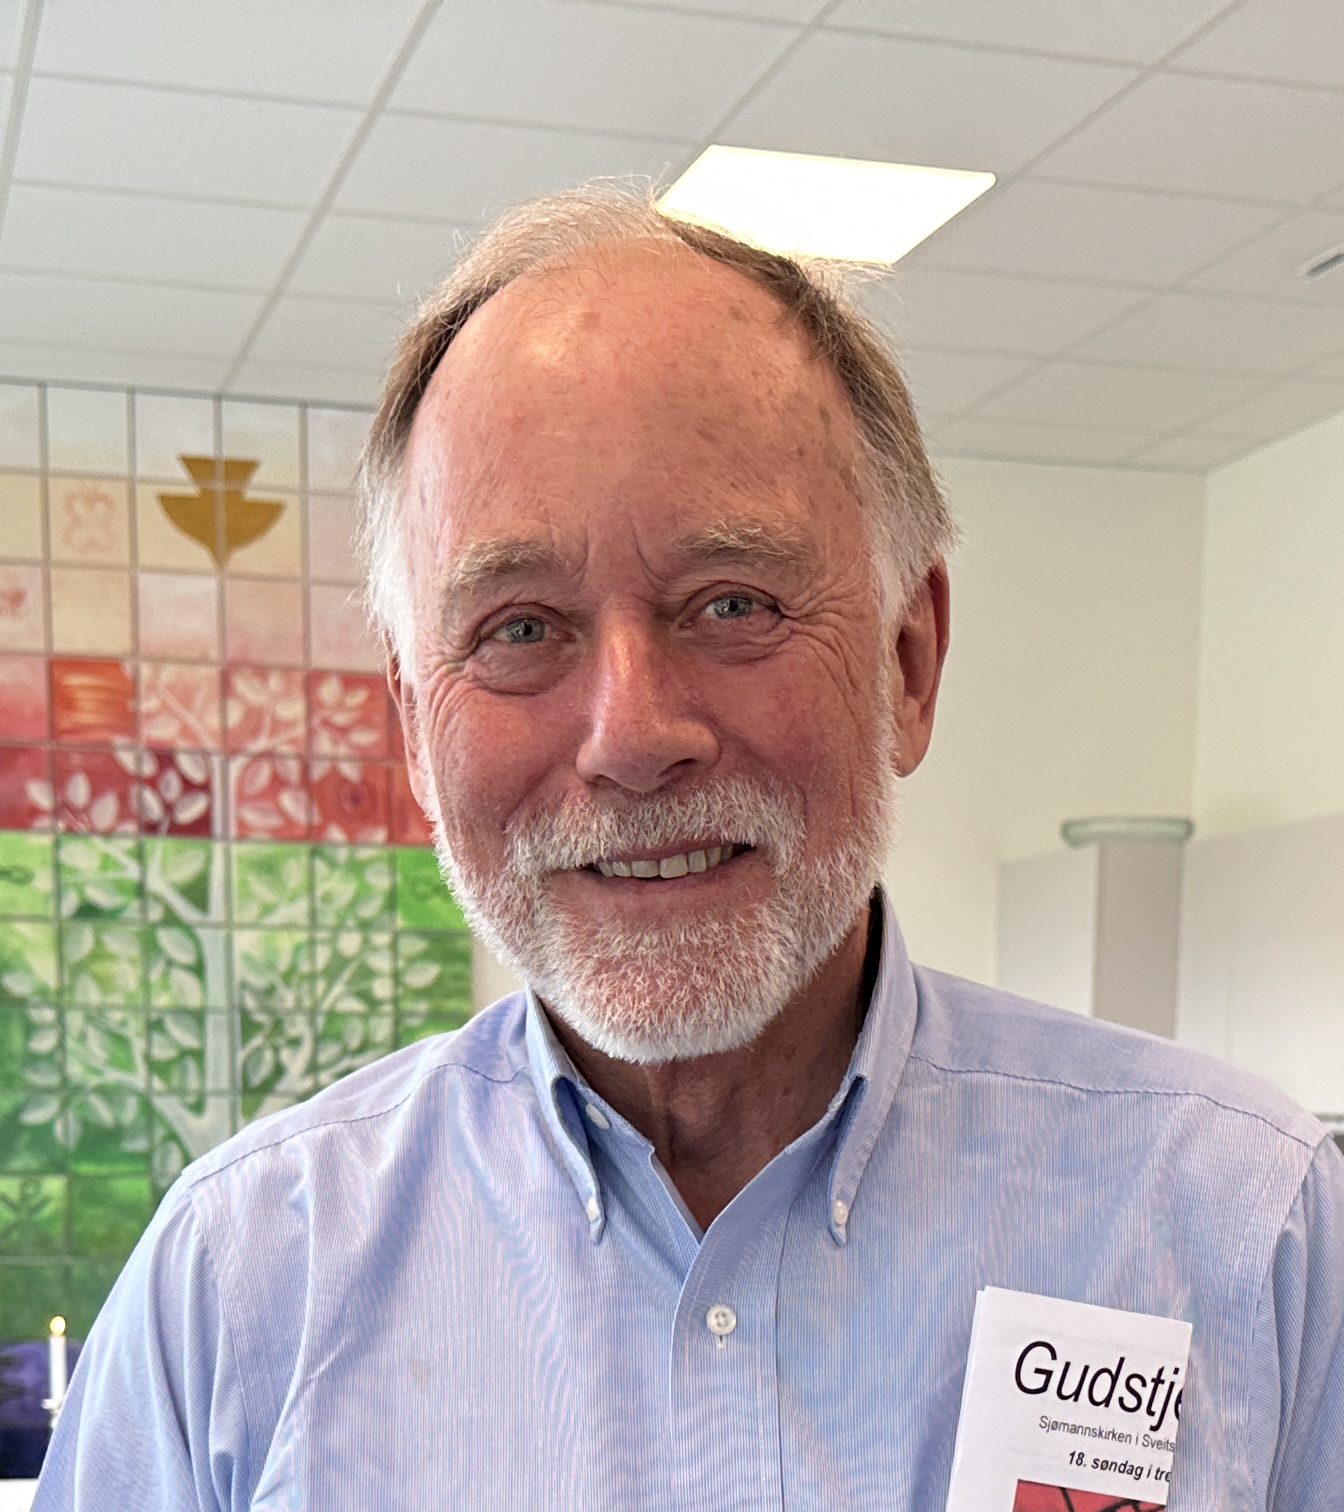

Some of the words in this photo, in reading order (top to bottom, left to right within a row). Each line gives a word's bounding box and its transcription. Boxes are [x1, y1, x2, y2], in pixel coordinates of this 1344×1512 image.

[1038, 1415, 1132, 1445] Sjømannskirken
[1068, 1450, 1087, 1467] 18.
[1090, 1457, 1144, 1481] søndag
[1145, 1464, 1154, 1479] i
